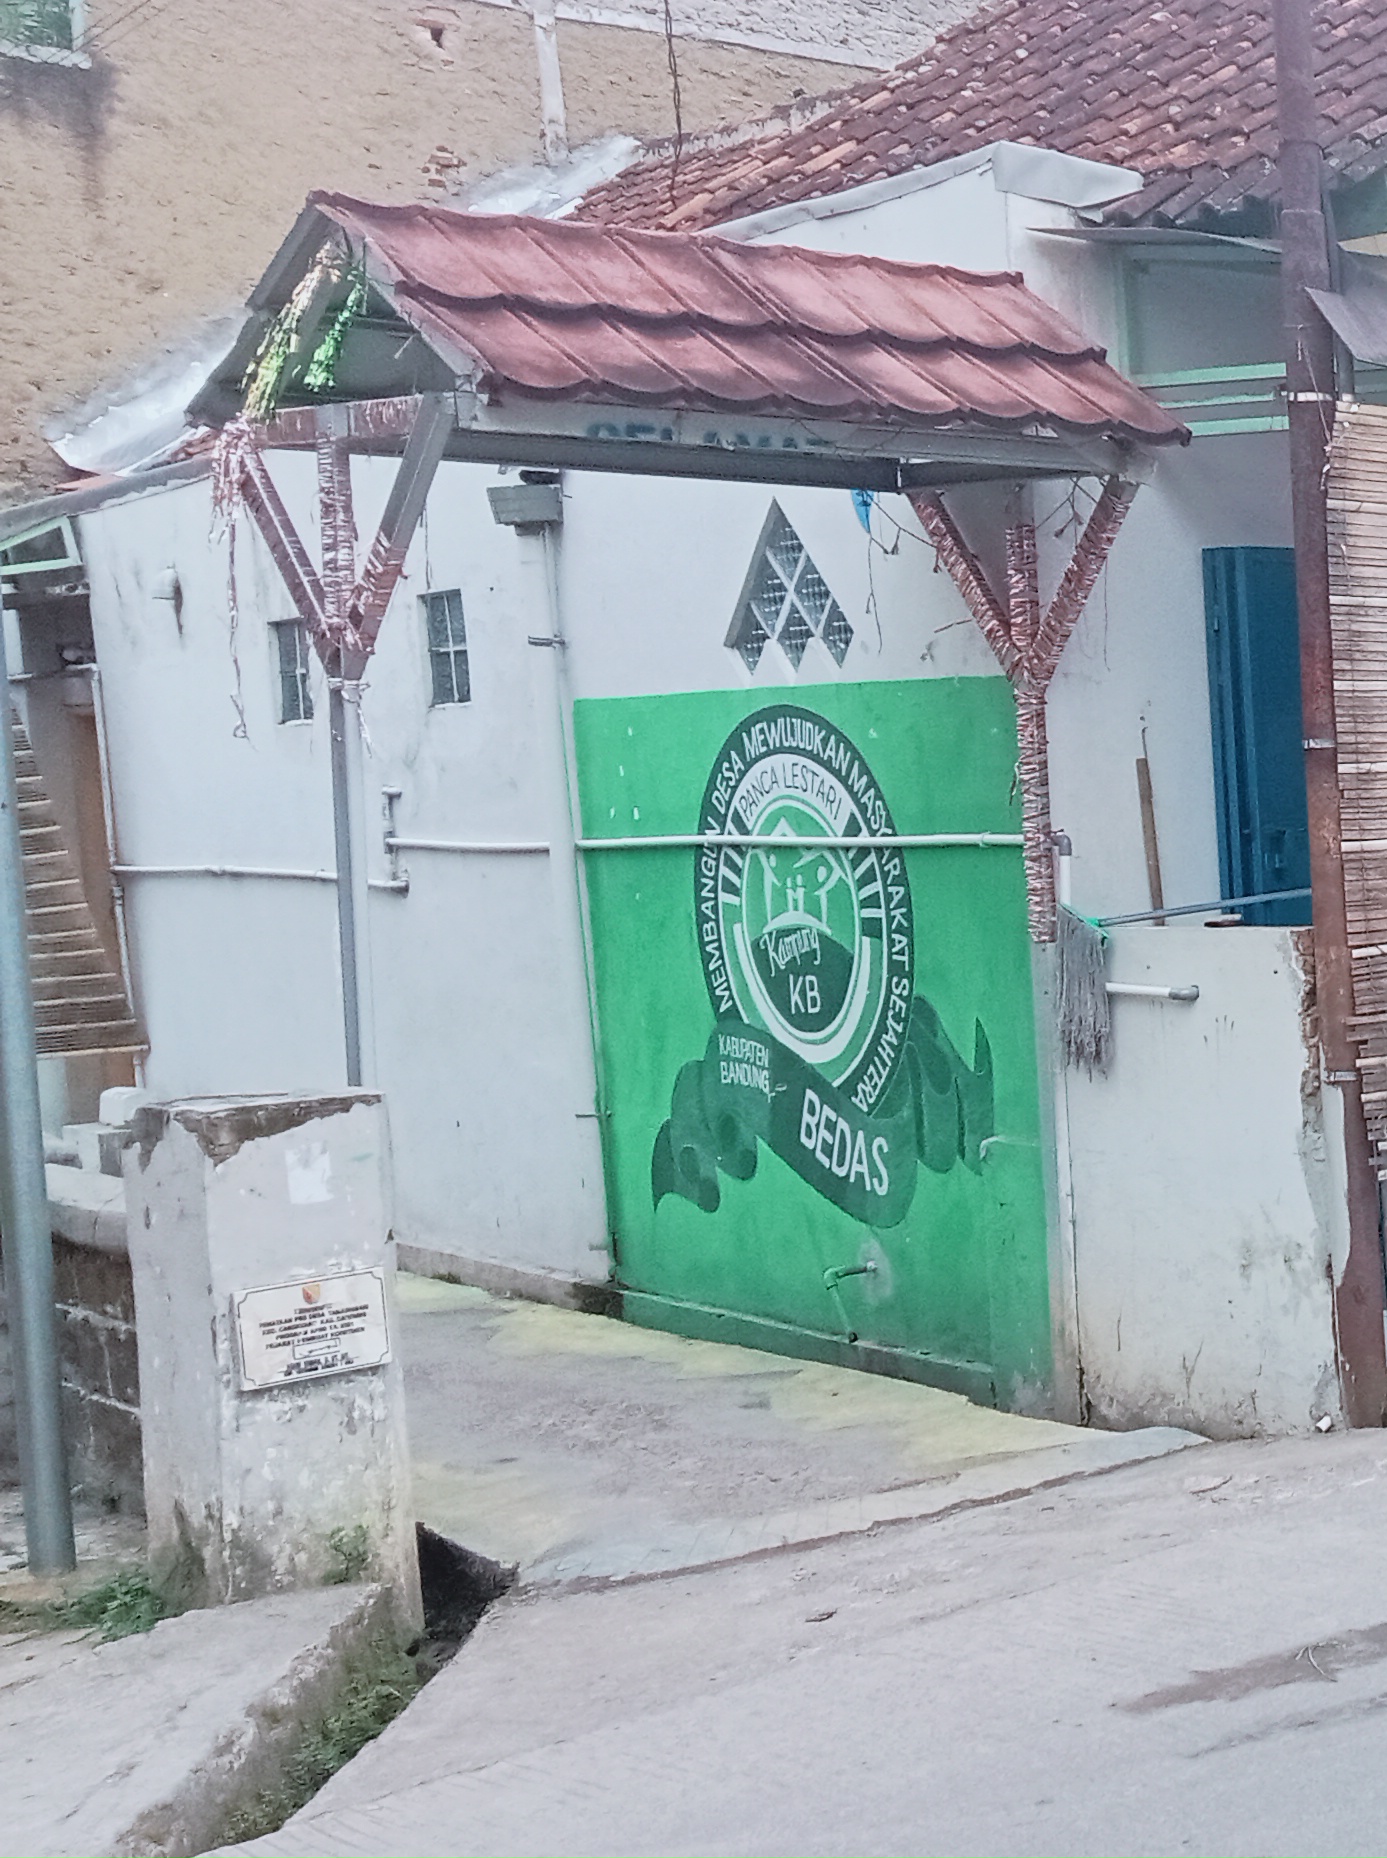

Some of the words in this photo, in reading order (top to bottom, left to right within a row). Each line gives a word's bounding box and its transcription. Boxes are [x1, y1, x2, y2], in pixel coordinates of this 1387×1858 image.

[739, 765, 781, 816] PANCA
[782, 763, 842, 820] LESTARI
[711, 750, 745, 814] DESA
[742, 716, 852, 776] MEWUJUDKAN
[851, 976, 910, 1112] SEJAHTERA
[760, 928, 821, 976] Kampung
[789, 974, 821, 1014] KB
[718, 1034, 769, 1068] KABUPATEN
[720, 1061, 770, 1094] BANDUNG
[800, 1088, 889, 1195] BEDAS
